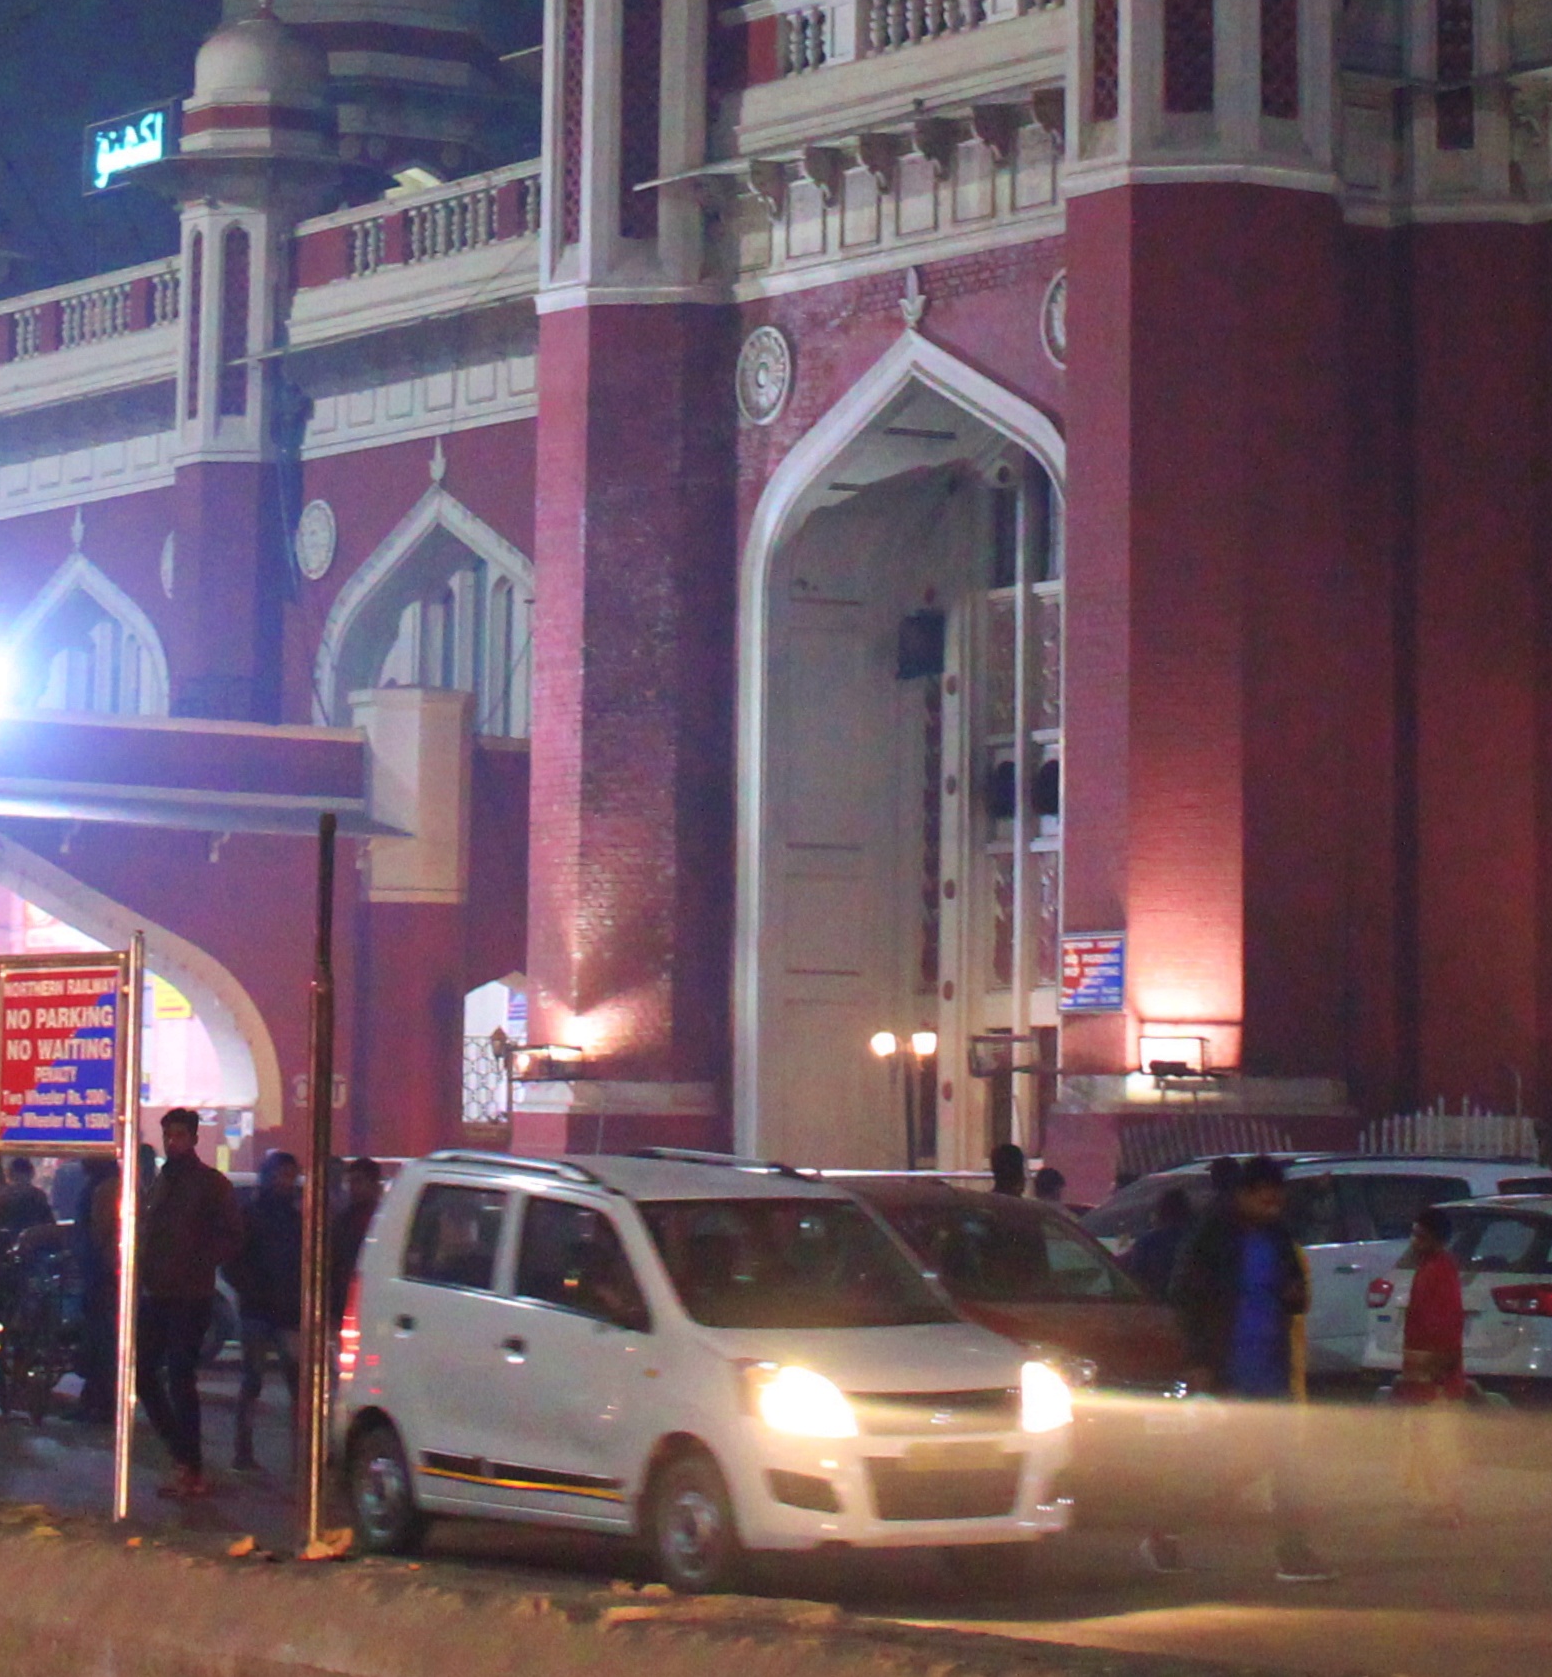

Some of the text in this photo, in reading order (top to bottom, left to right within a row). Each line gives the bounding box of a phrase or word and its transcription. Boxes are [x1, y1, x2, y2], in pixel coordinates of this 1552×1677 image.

[4, 977, 116, 997] NORTHERN RAILWAY
[6, 1005, 113, 1030] NO PARKING
[6, 1038, 112, 1060] NO WAITING
[34, 1065, 78, 1083] PENALTY
